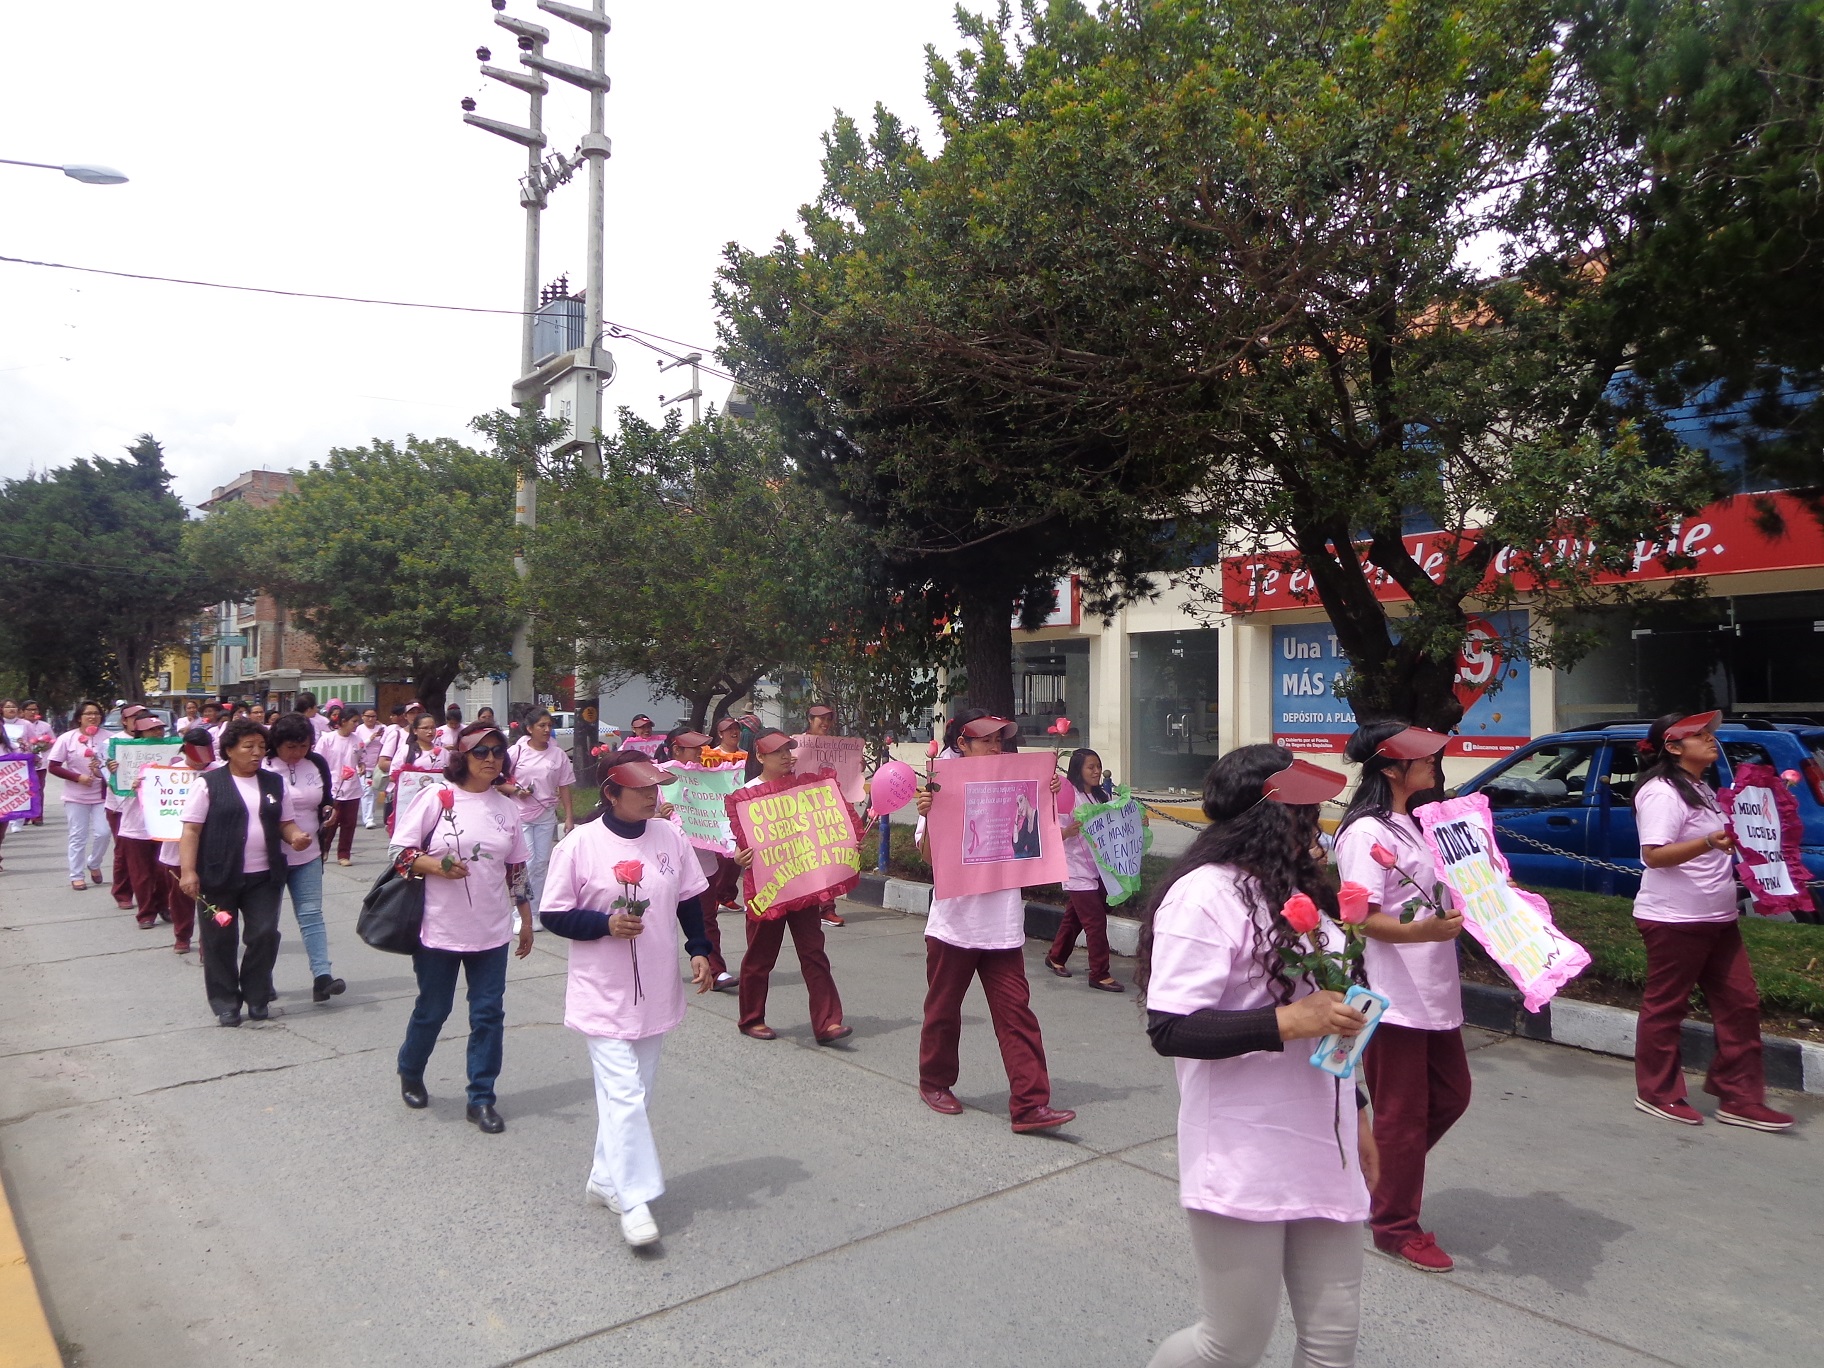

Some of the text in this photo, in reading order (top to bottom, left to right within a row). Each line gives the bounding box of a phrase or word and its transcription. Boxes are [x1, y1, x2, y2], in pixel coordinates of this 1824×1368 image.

[1283, 637, 1321, 660] Una
[1282, 667, 1325, 696] MÁS
[1283, 711, 1357, 723] DEPÓSITO A PLAZ
[1, 773, 22, 788] TUS
[675, 804, 708, 818] REVENIR
[711, 810, 718, 819] Y
[748, 785, 837, 825] CUIDATE
[687, 816, 720, 829] CANCER
[753, 807, 845, 843] O SERAS UNA
[760, 835, 816, 867] VICTIMA
[821, 849, 832, 866] A
